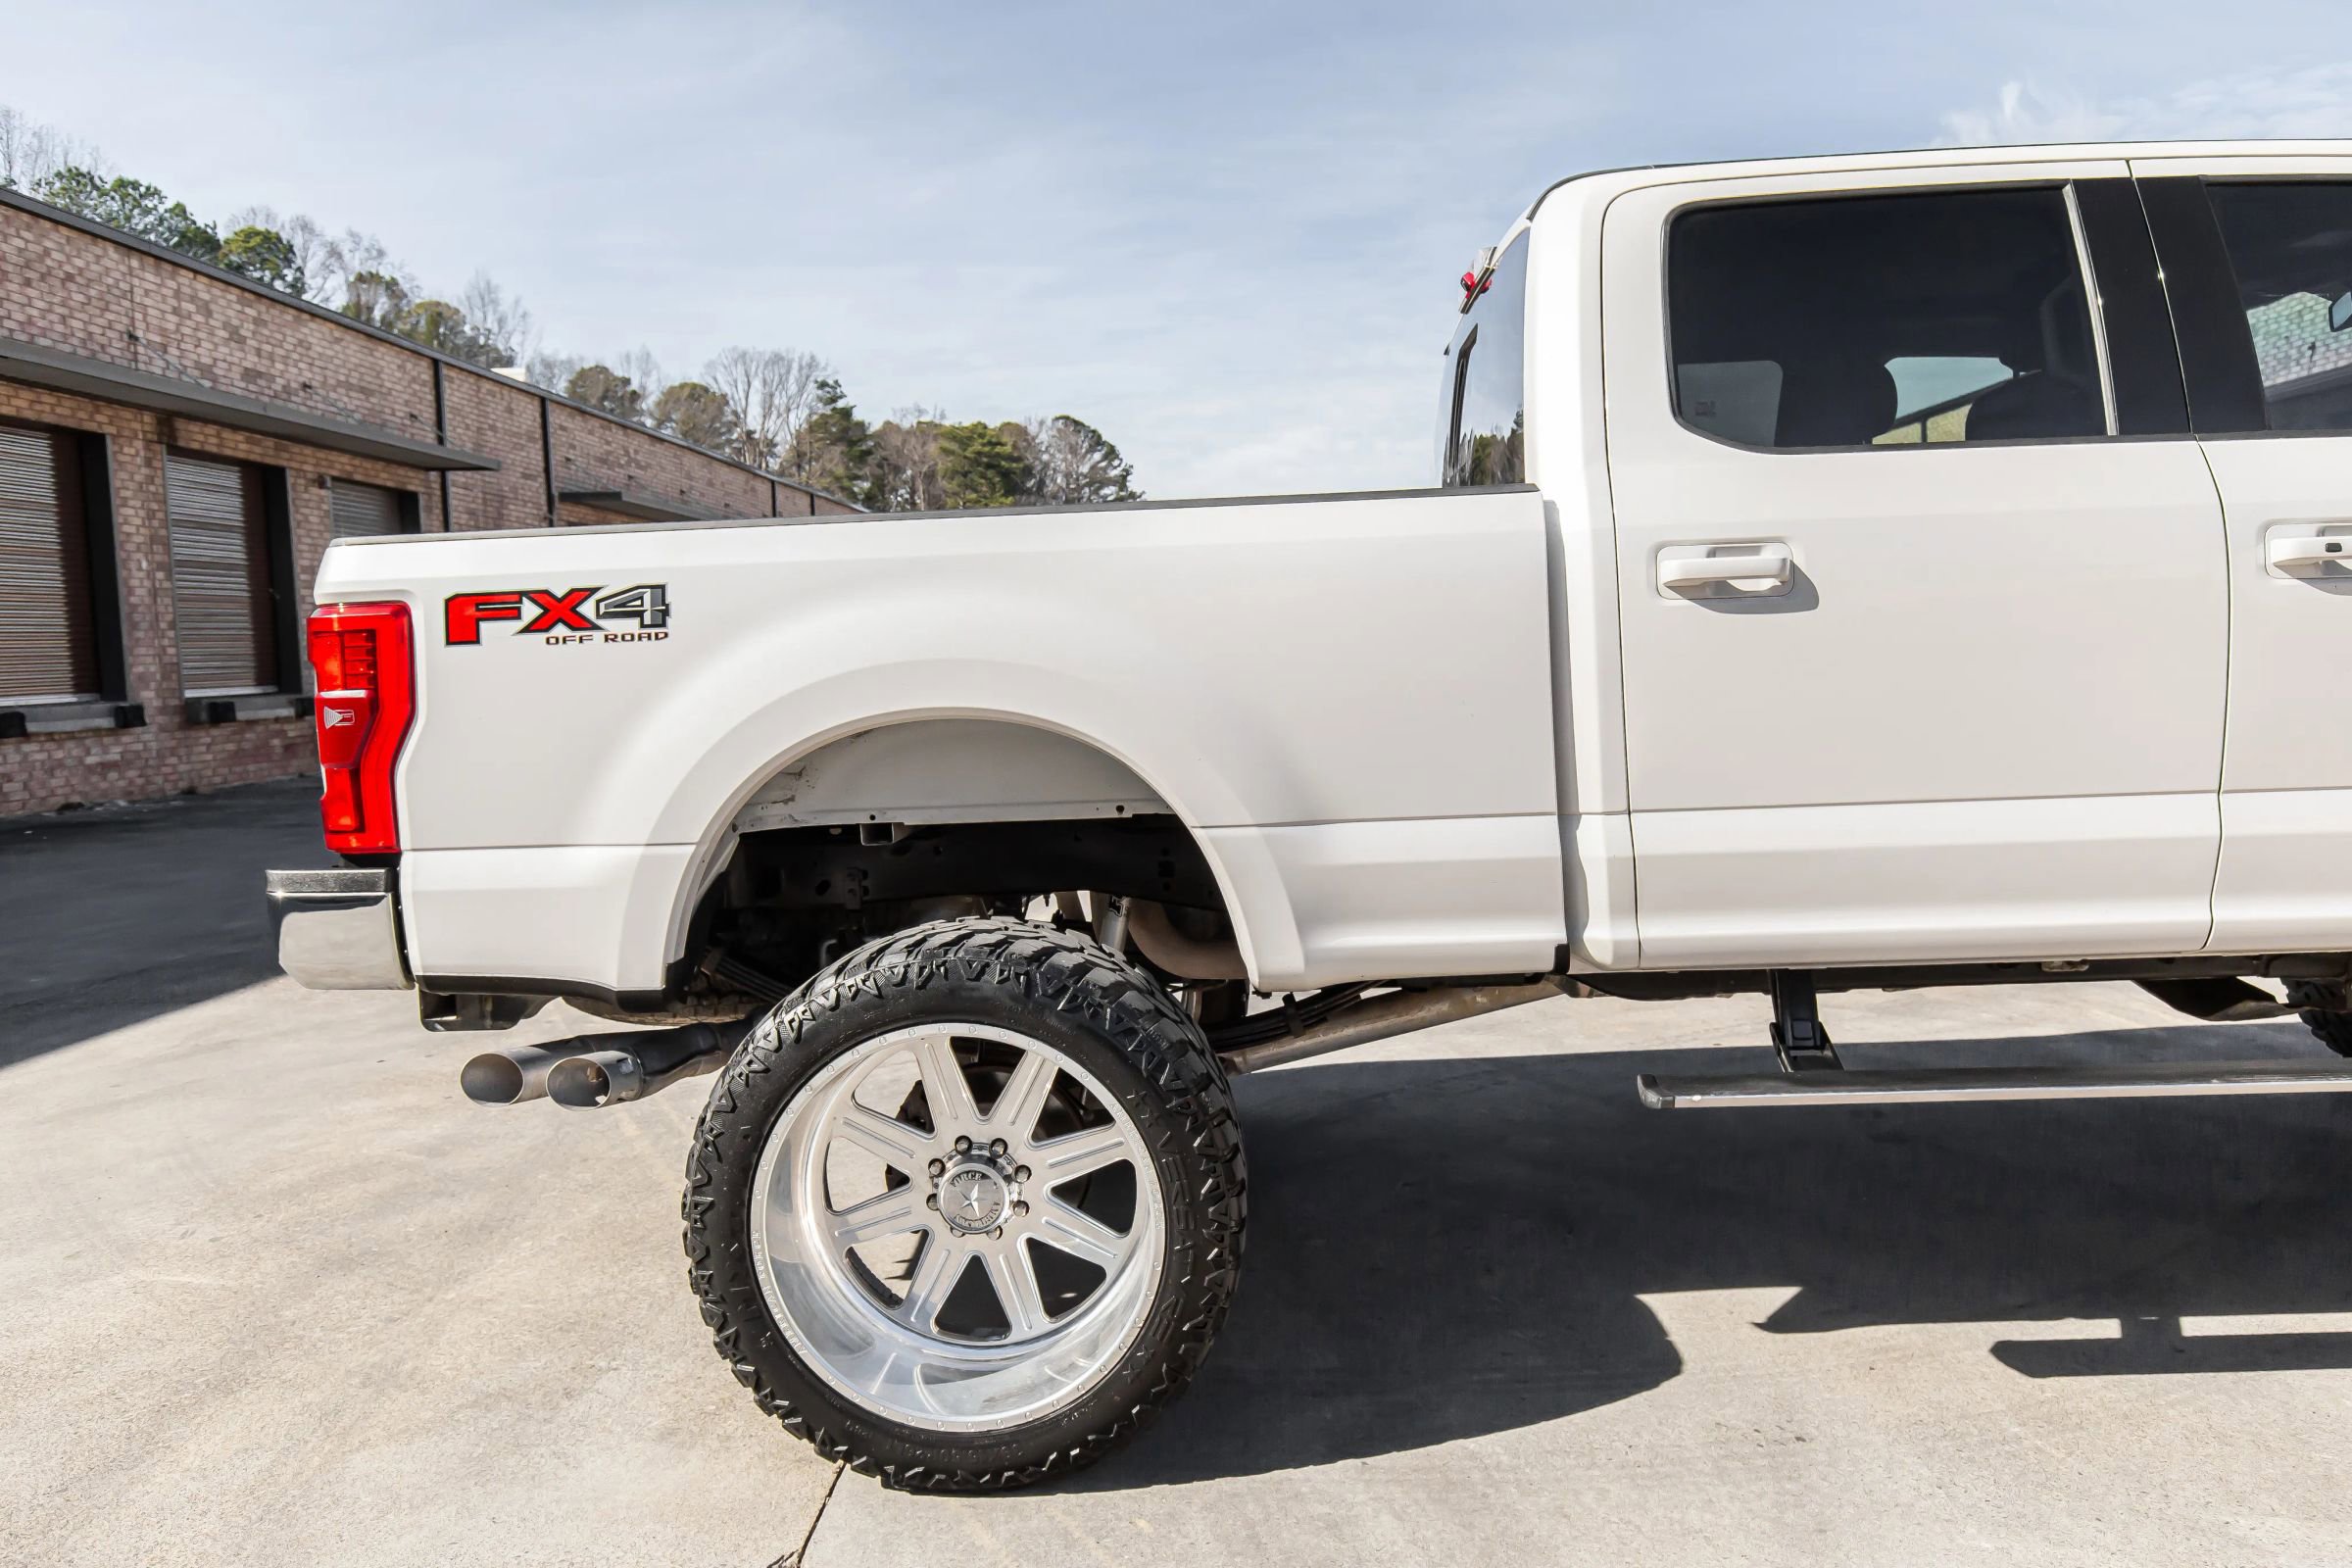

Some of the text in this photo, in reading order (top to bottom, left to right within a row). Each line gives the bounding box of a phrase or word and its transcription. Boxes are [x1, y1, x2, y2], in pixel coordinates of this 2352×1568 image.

[444, 582, 671, 647] FX4
[546, 632, 668, 646] OFF ROAD
[1109, 1102, 1154, 1176] AMERICAN
[752, 1231, 808, 1355] AMERICAN FORCE
